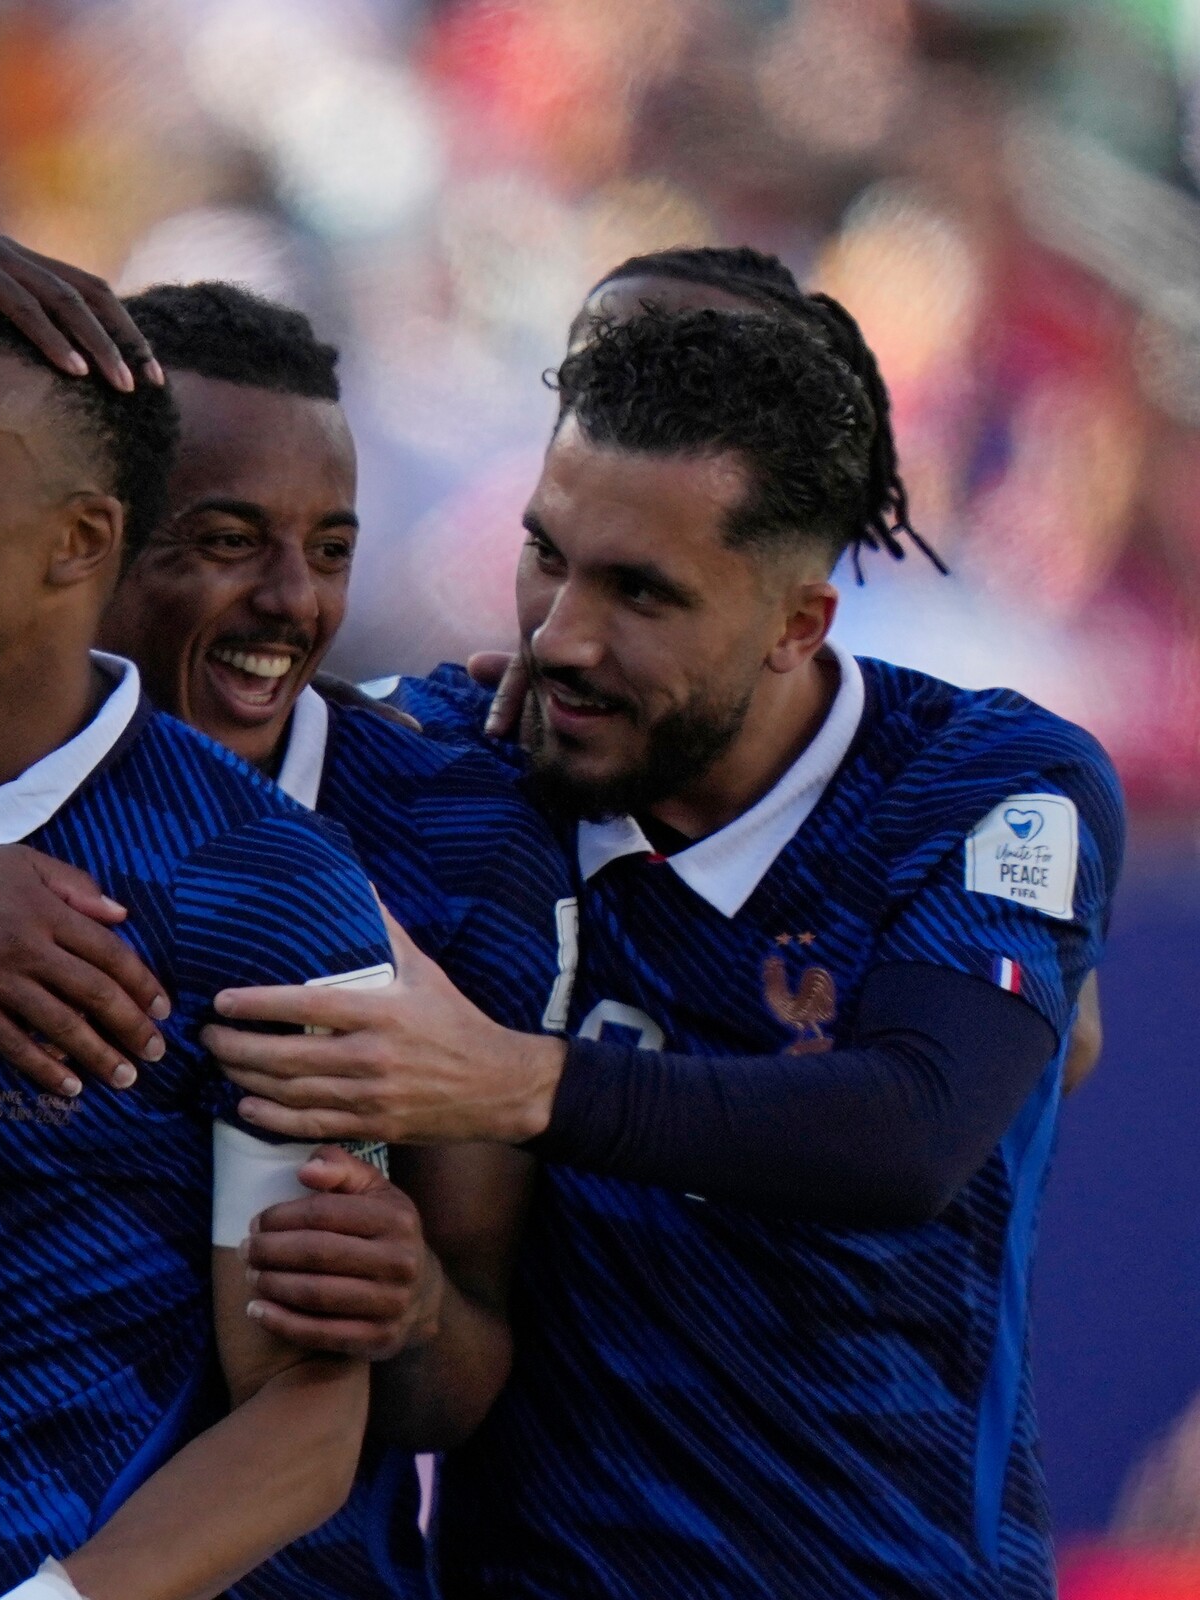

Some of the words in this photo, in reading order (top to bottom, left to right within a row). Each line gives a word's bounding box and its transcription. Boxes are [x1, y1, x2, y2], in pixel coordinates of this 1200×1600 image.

[995, 843, 1033, 862] Unite
[1032, 845, 1053, 864] For
[1000, 863, 1050, 888] PEACE
[1010, 887, 1036, 900] FIFA
